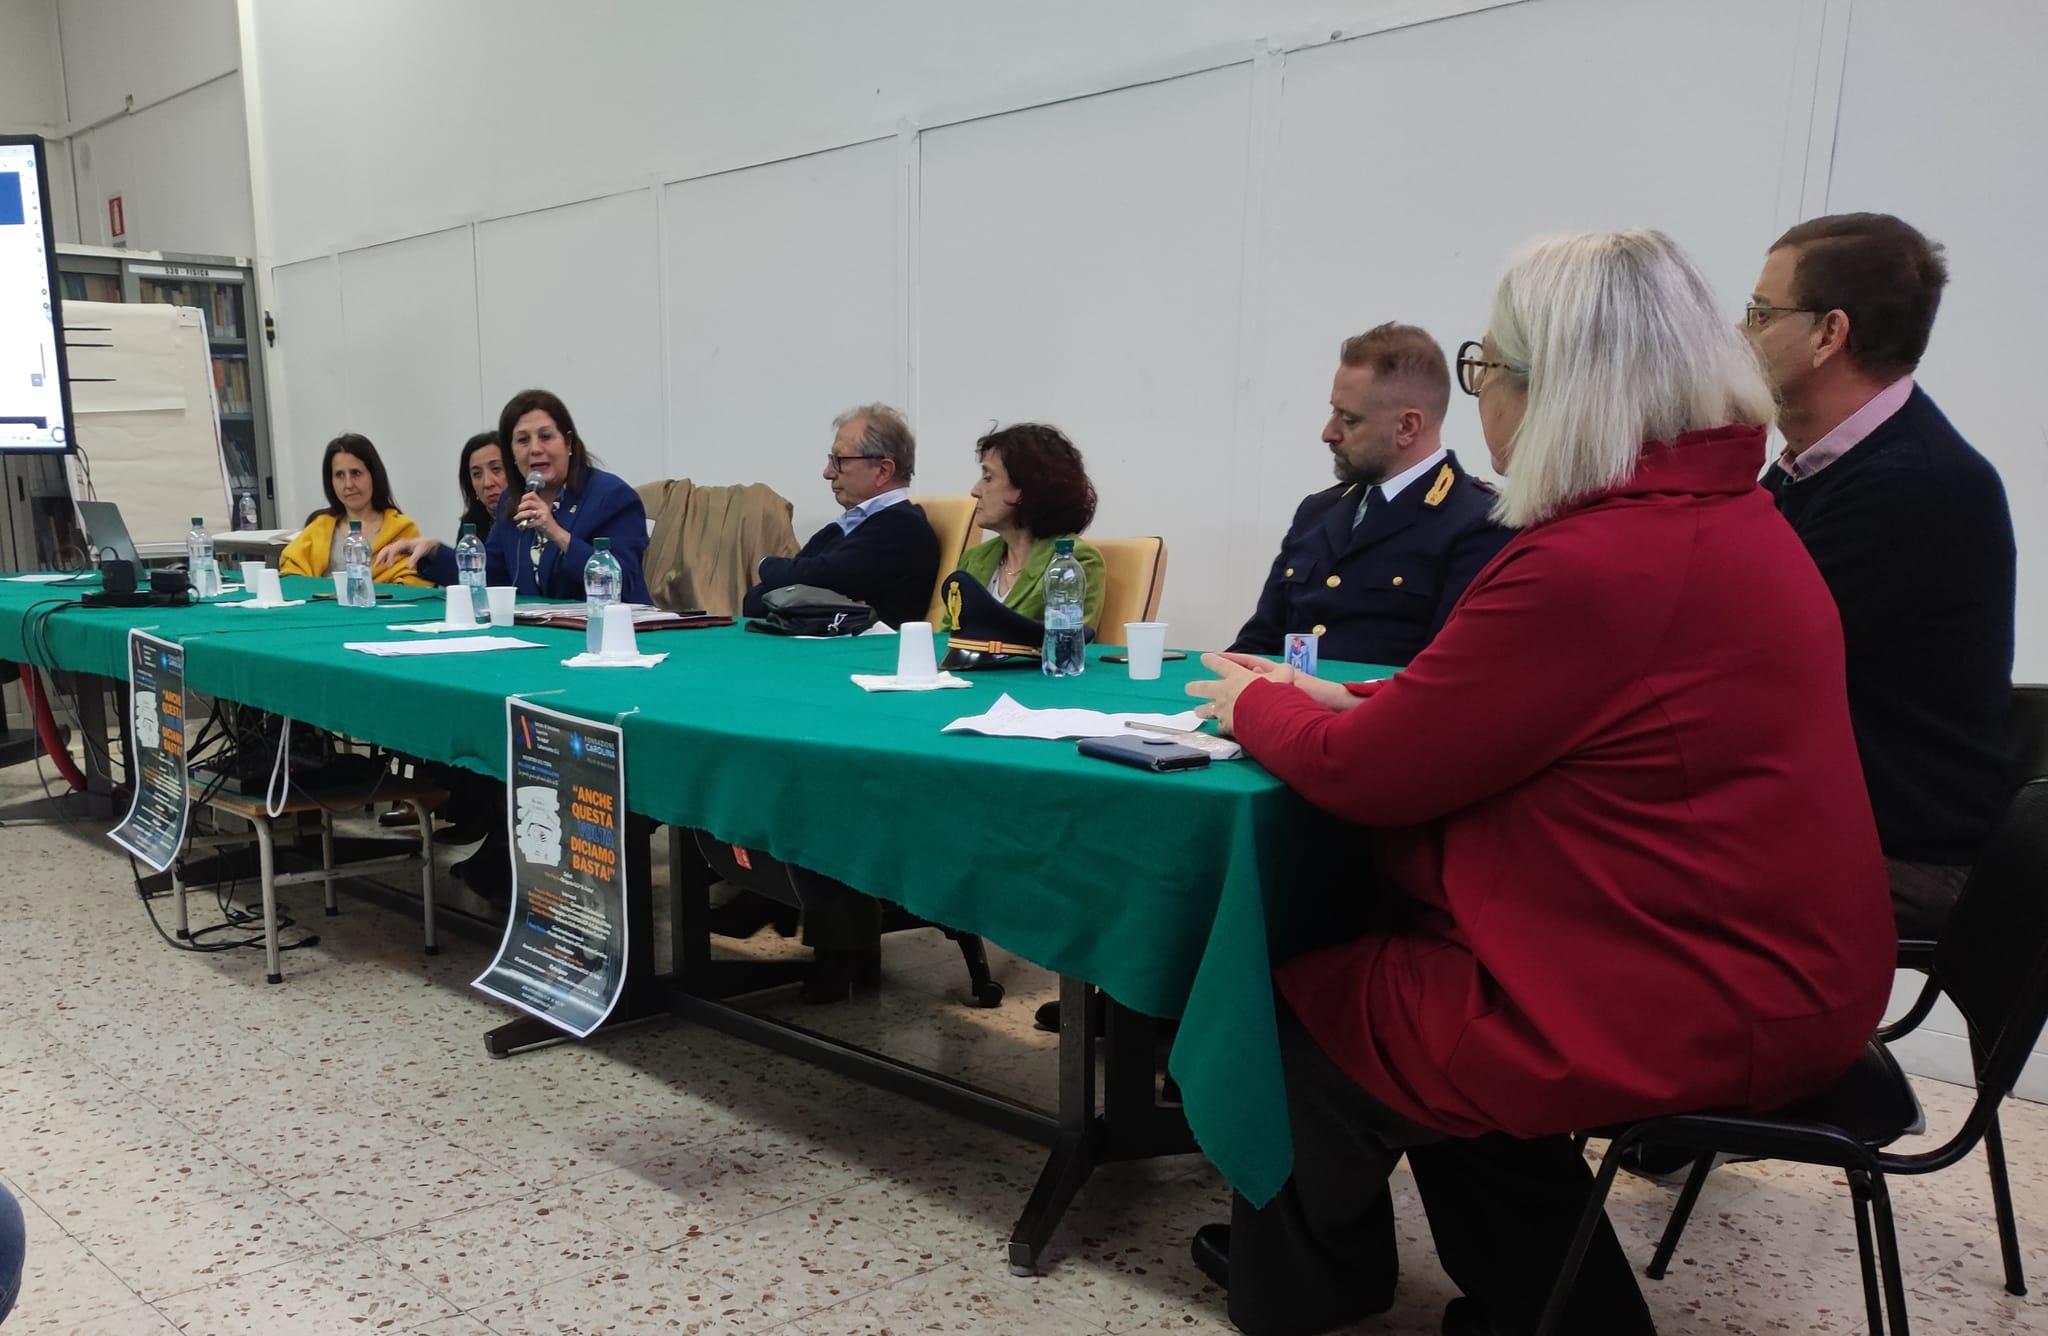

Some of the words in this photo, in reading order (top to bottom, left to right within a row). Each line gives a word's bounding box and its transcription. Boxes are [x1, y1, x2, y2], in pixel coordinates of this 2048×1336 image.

[186, 267, 209, 277] FISICA
[585, 743, 616, 759] CAROLINA
[571, 801, 614, 830] QUESTA
[577, 820, 615, 848] VOLTA
[570, 835, 615, 865] DICIAMO
